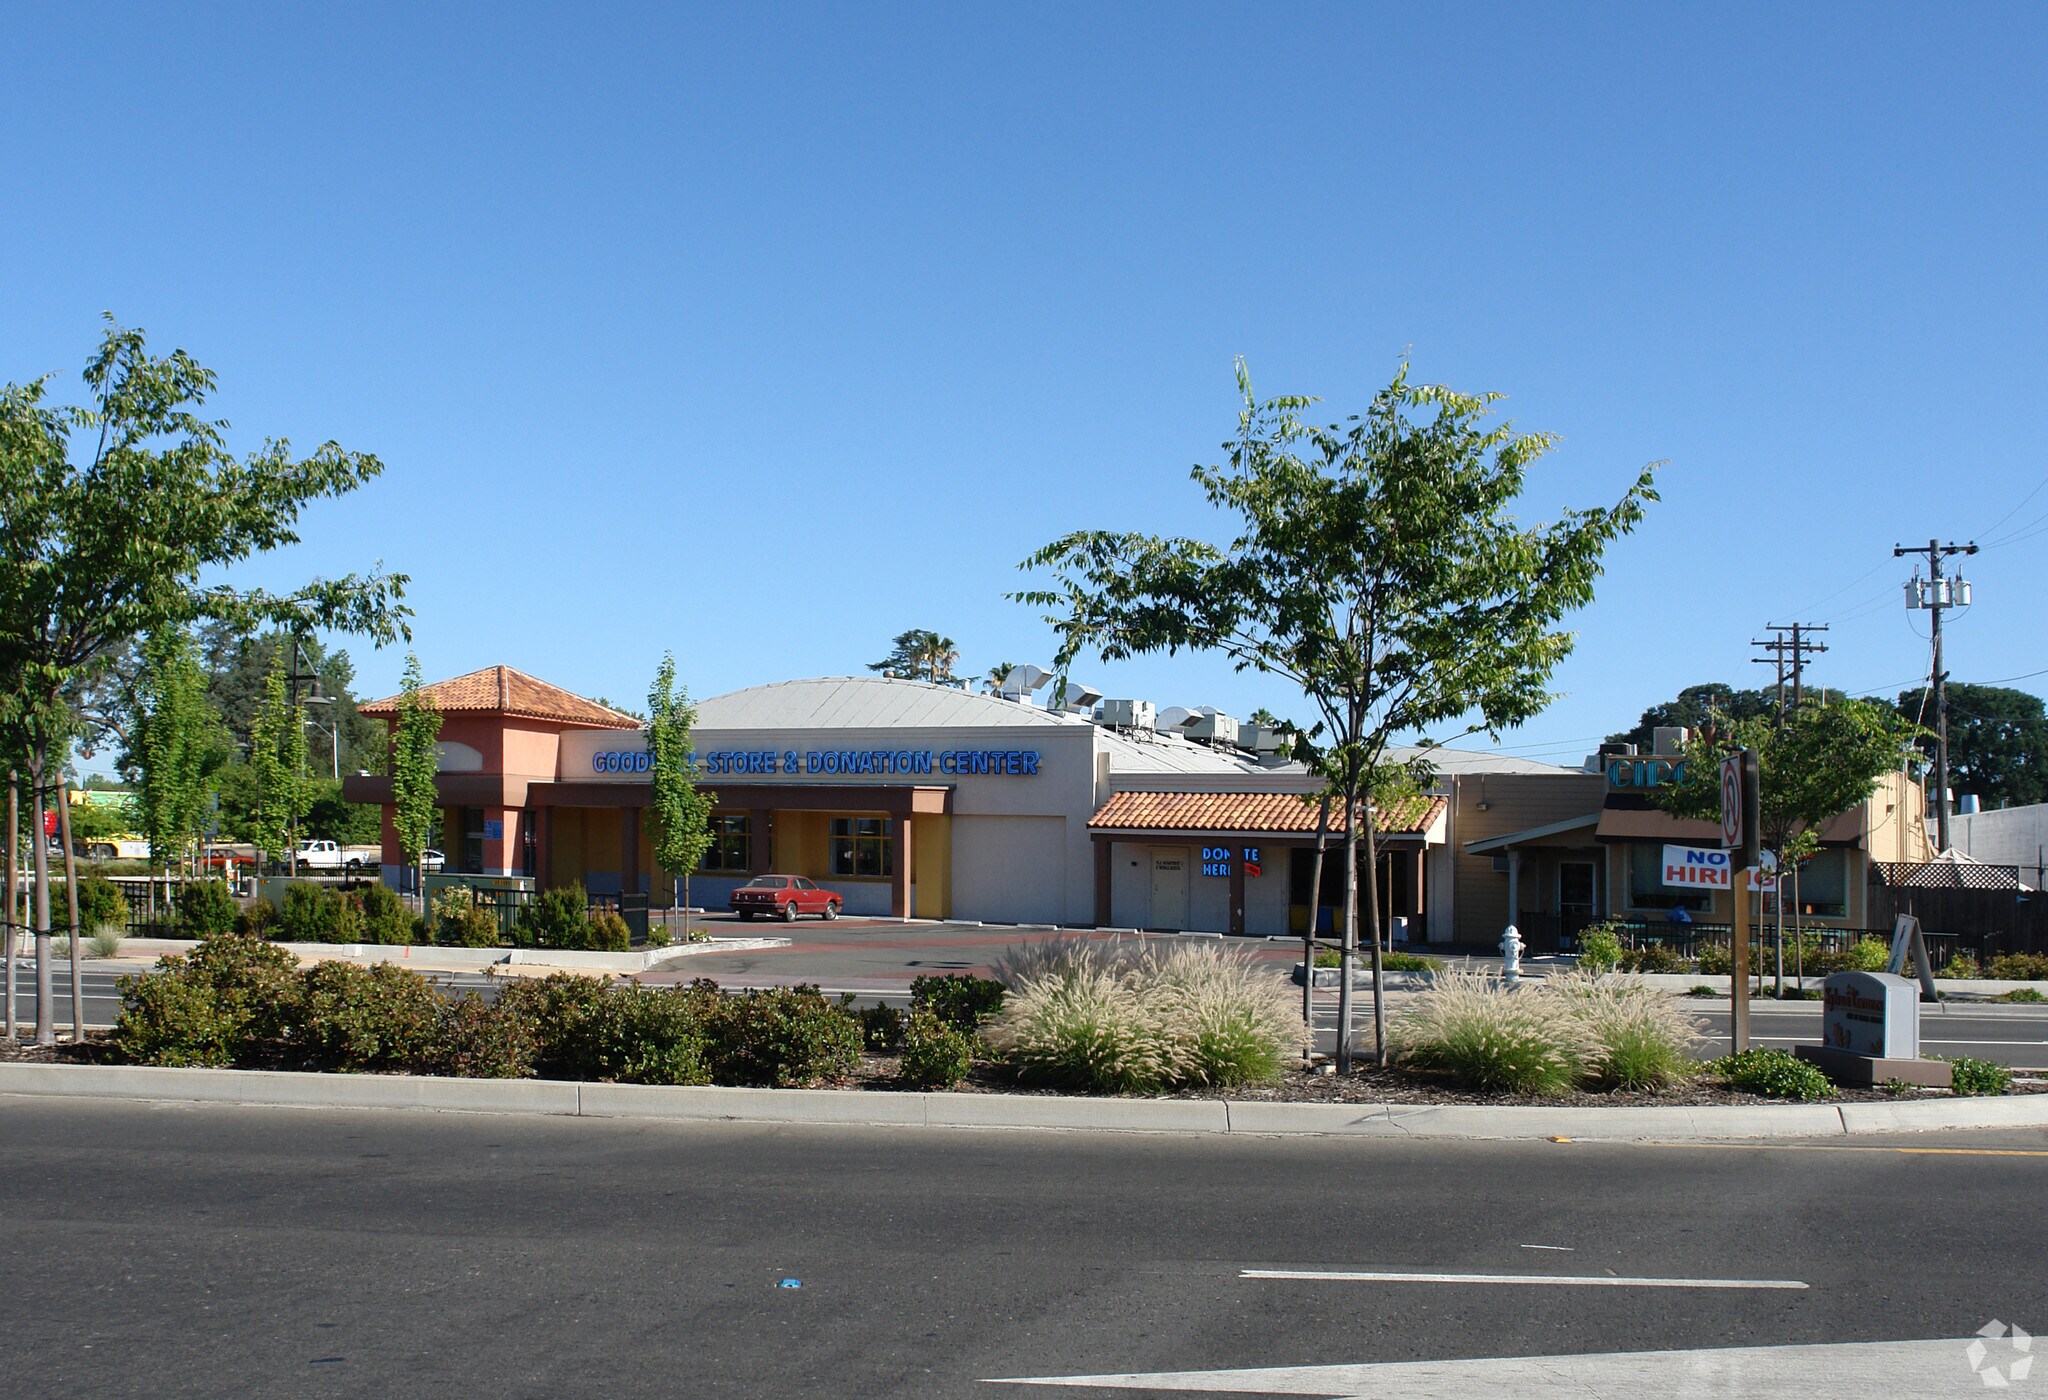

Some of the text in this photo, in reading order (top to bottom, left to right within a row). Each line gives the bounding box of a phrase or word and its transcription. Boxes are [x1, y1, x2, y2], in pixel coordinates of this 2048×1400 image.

[706, 752, 777, 774] STORE
[783, 752, 799, 774] &
[806, 751, 933, 774] DONATION
[939, 751, 1041, 775] CENTER
[1202, 847, 1260, 861] DONTE
[1687, 850, 1733, 865] NO
[1666, 865, 1775, 887] HIRIG
